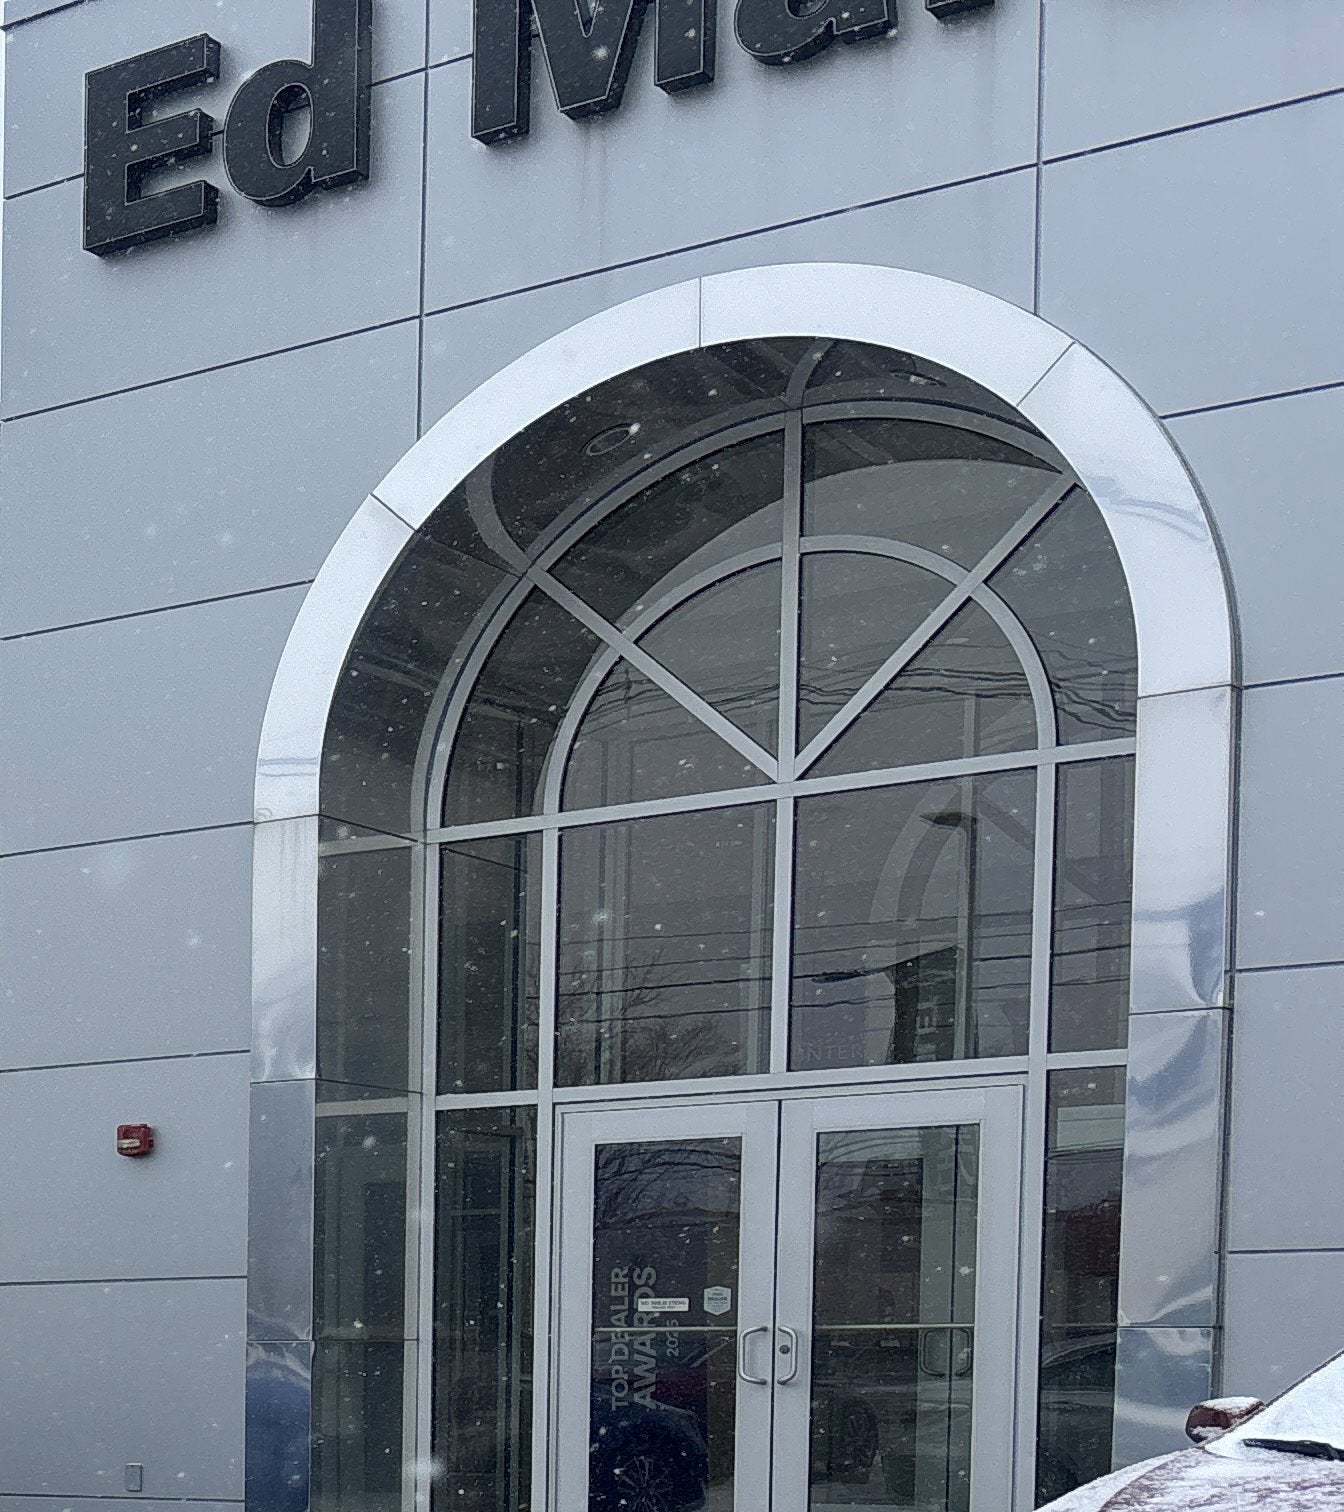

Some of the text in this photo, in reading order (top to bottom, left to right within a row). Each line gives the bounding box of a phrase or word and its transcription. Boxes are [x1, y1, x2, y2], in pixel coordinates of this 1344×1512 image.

[83, 0, 372, 257] Ed
[610, 1265, 629, 1411] TOP DEALER
[633, 1265, 657, 1410] AWARDS
